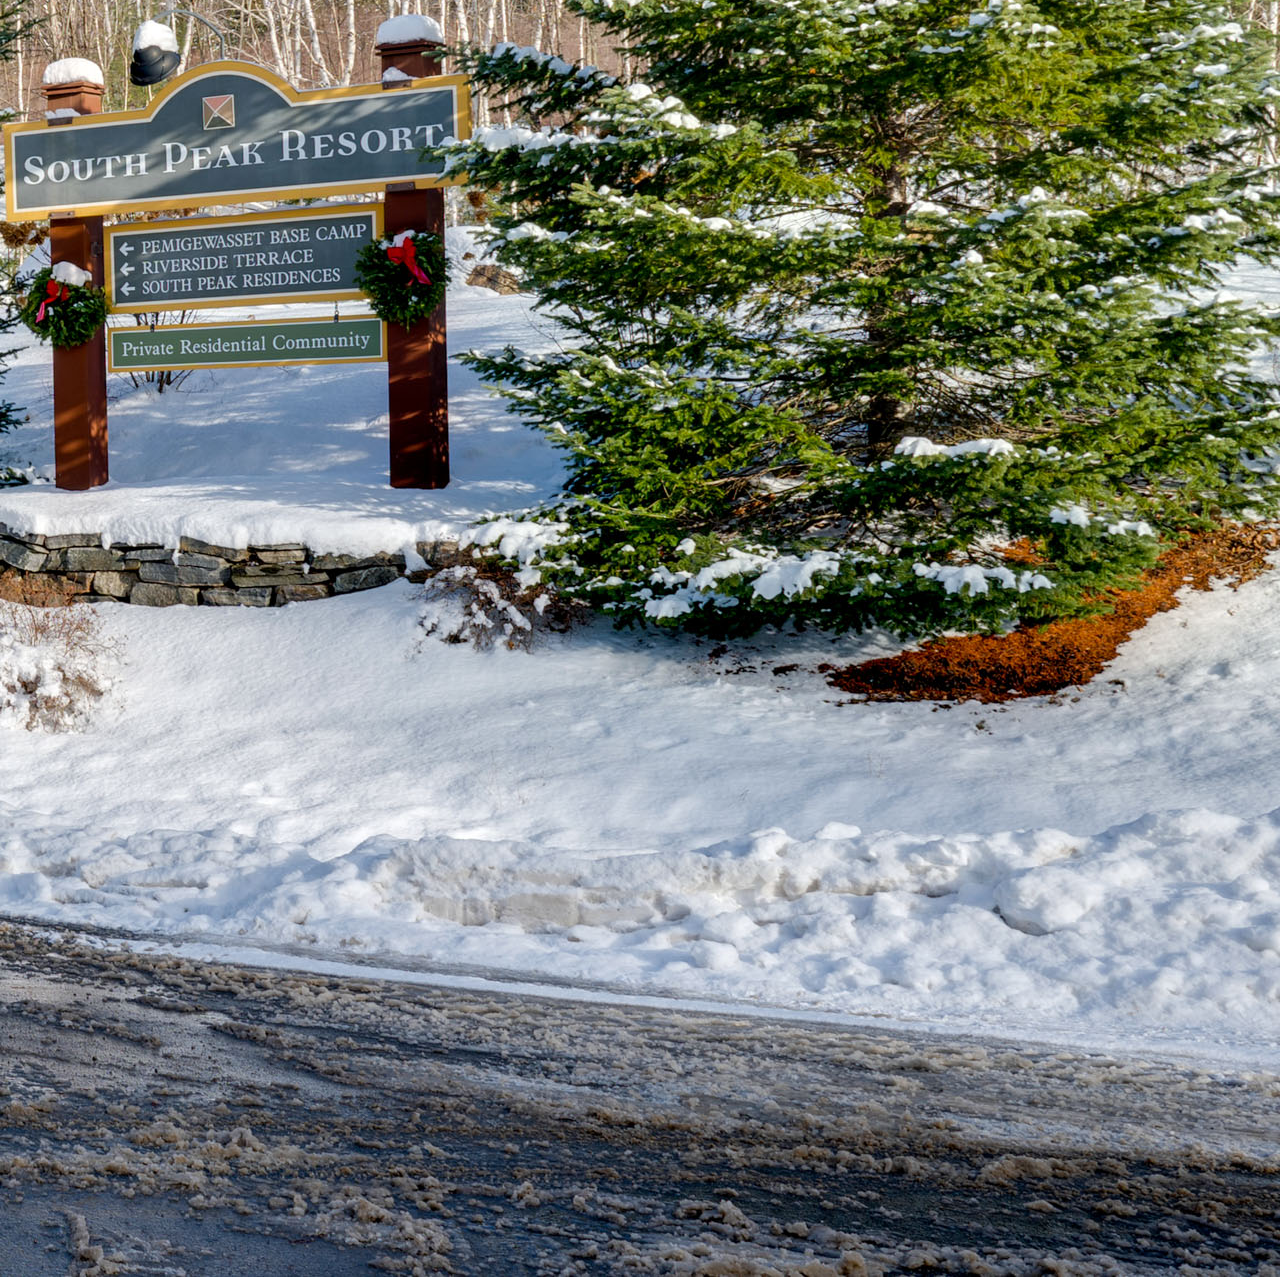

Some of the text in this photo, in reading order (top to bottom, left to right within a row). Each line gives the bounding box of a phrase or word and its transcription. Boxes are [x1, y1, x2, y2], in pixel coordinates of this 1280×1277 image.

[141, 223, 367, 255] PEMIGEWASSET BASE CAMP
[142, 249, 314, 275] RIVERSIDE TERRACE
[142, 268, 341, 295] SOUTH PEAK RESIDENCES
[122, 331, 371, 357] Private Residential Community
